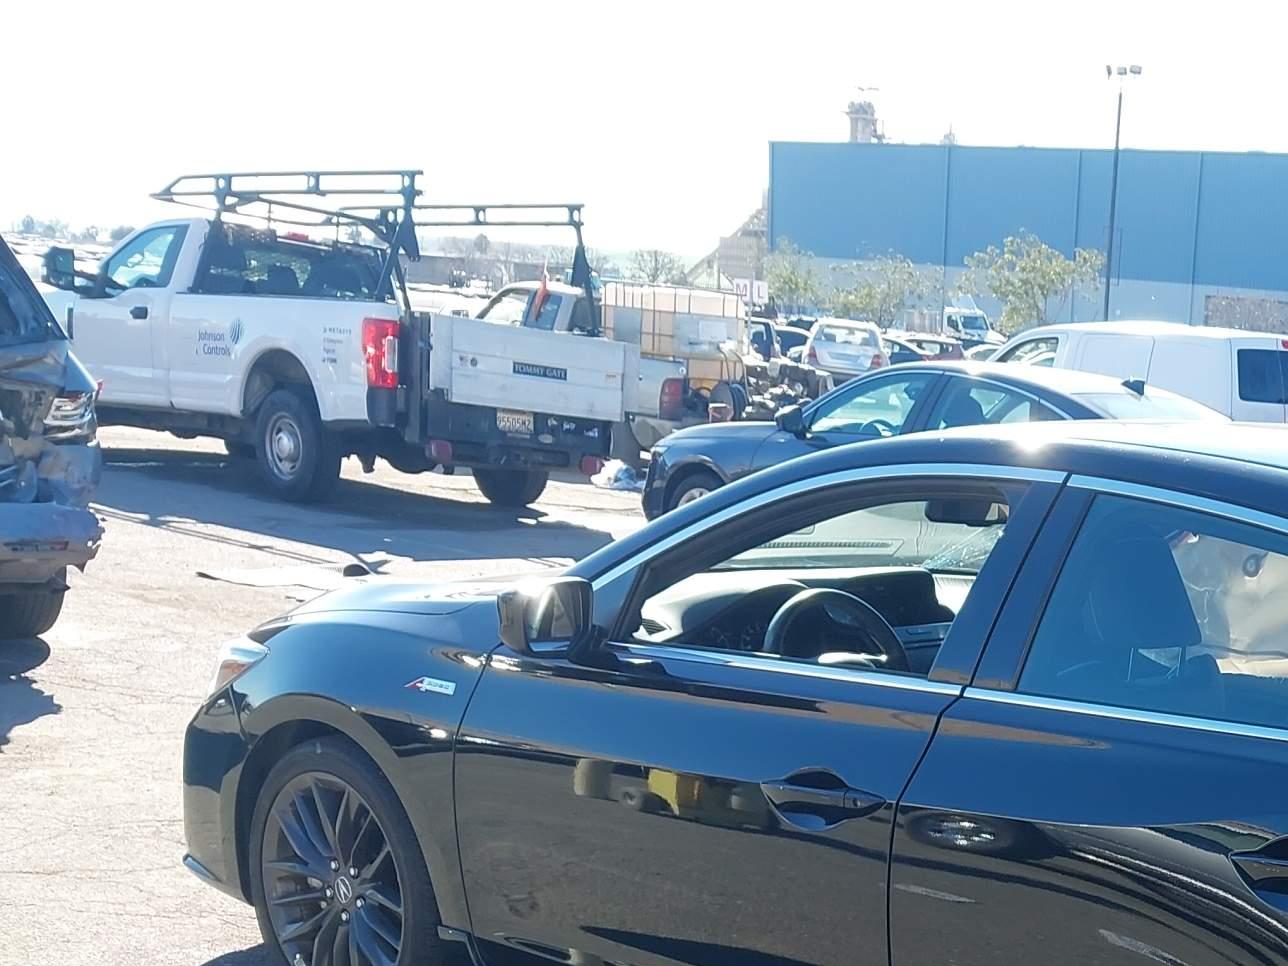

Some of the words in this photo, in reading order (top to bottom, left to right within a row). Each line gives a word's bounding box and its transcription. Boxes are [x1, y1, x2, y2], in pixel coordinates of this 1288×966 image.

[735, 283, 748, 297] M
[757, 285, 765, 299] L
[198, 329, 225, 343] Johnson
[203, 344, 231, 357] Controls
[514, 363, 545, 377] TOMMY
[546, 367, 567, 379] GATE
